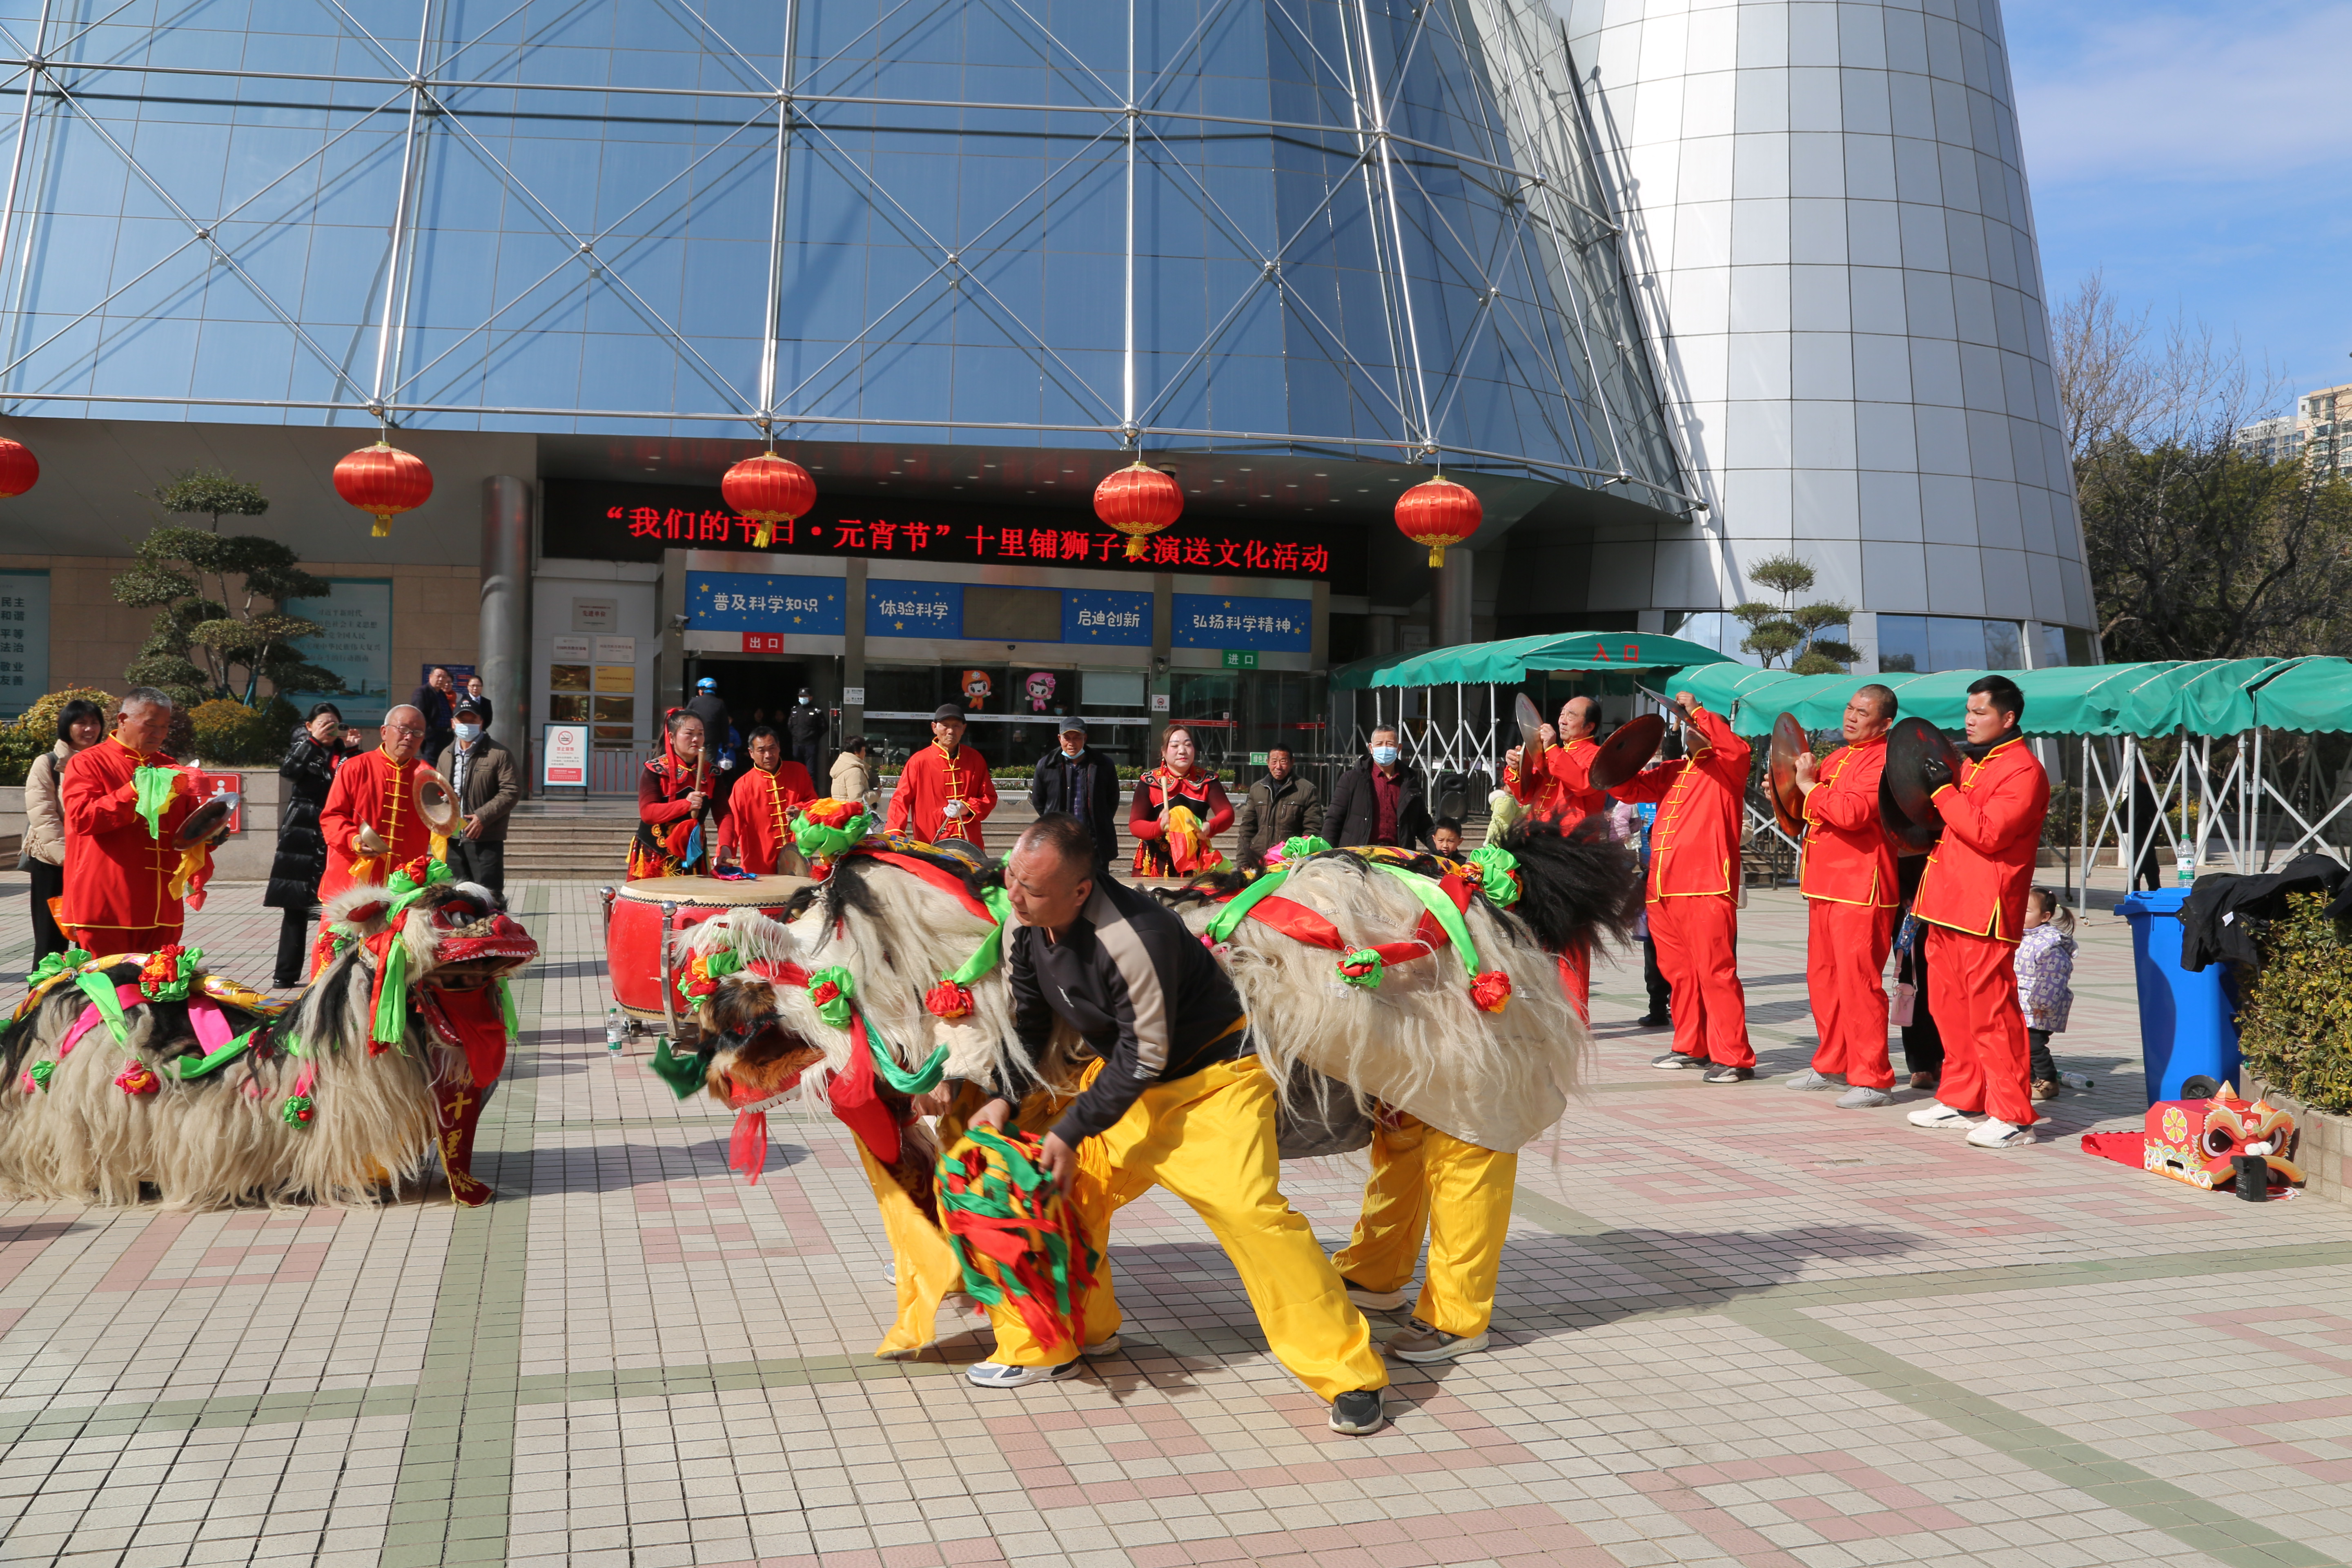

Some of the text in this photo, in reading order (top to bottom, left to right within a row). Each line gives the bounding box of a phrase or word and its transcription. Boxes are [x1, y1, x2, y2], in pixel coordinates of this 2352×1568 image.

[1, 597, 24, 607] 民主
[713, 593, 818, 613] 普及科学知识
[879, 600, 948, 619] 体验科学
[0, 611, 24, 621] 和谐
[1078, 609, 1140, 628] 启迪创新
[1194, 615, 1291, 633] 弘扬科学精神
[0, 629, 24, 639] 平等
[0, 643, 24, 653] 法治
[750, 636, 778, 649] 出口
[1592, 643, 1639, 662] 入口
[1228, 653, 1253, 665] 进口
[0, 662, 24, 672] 敬业
[0, 676, 23, 686] 友善
